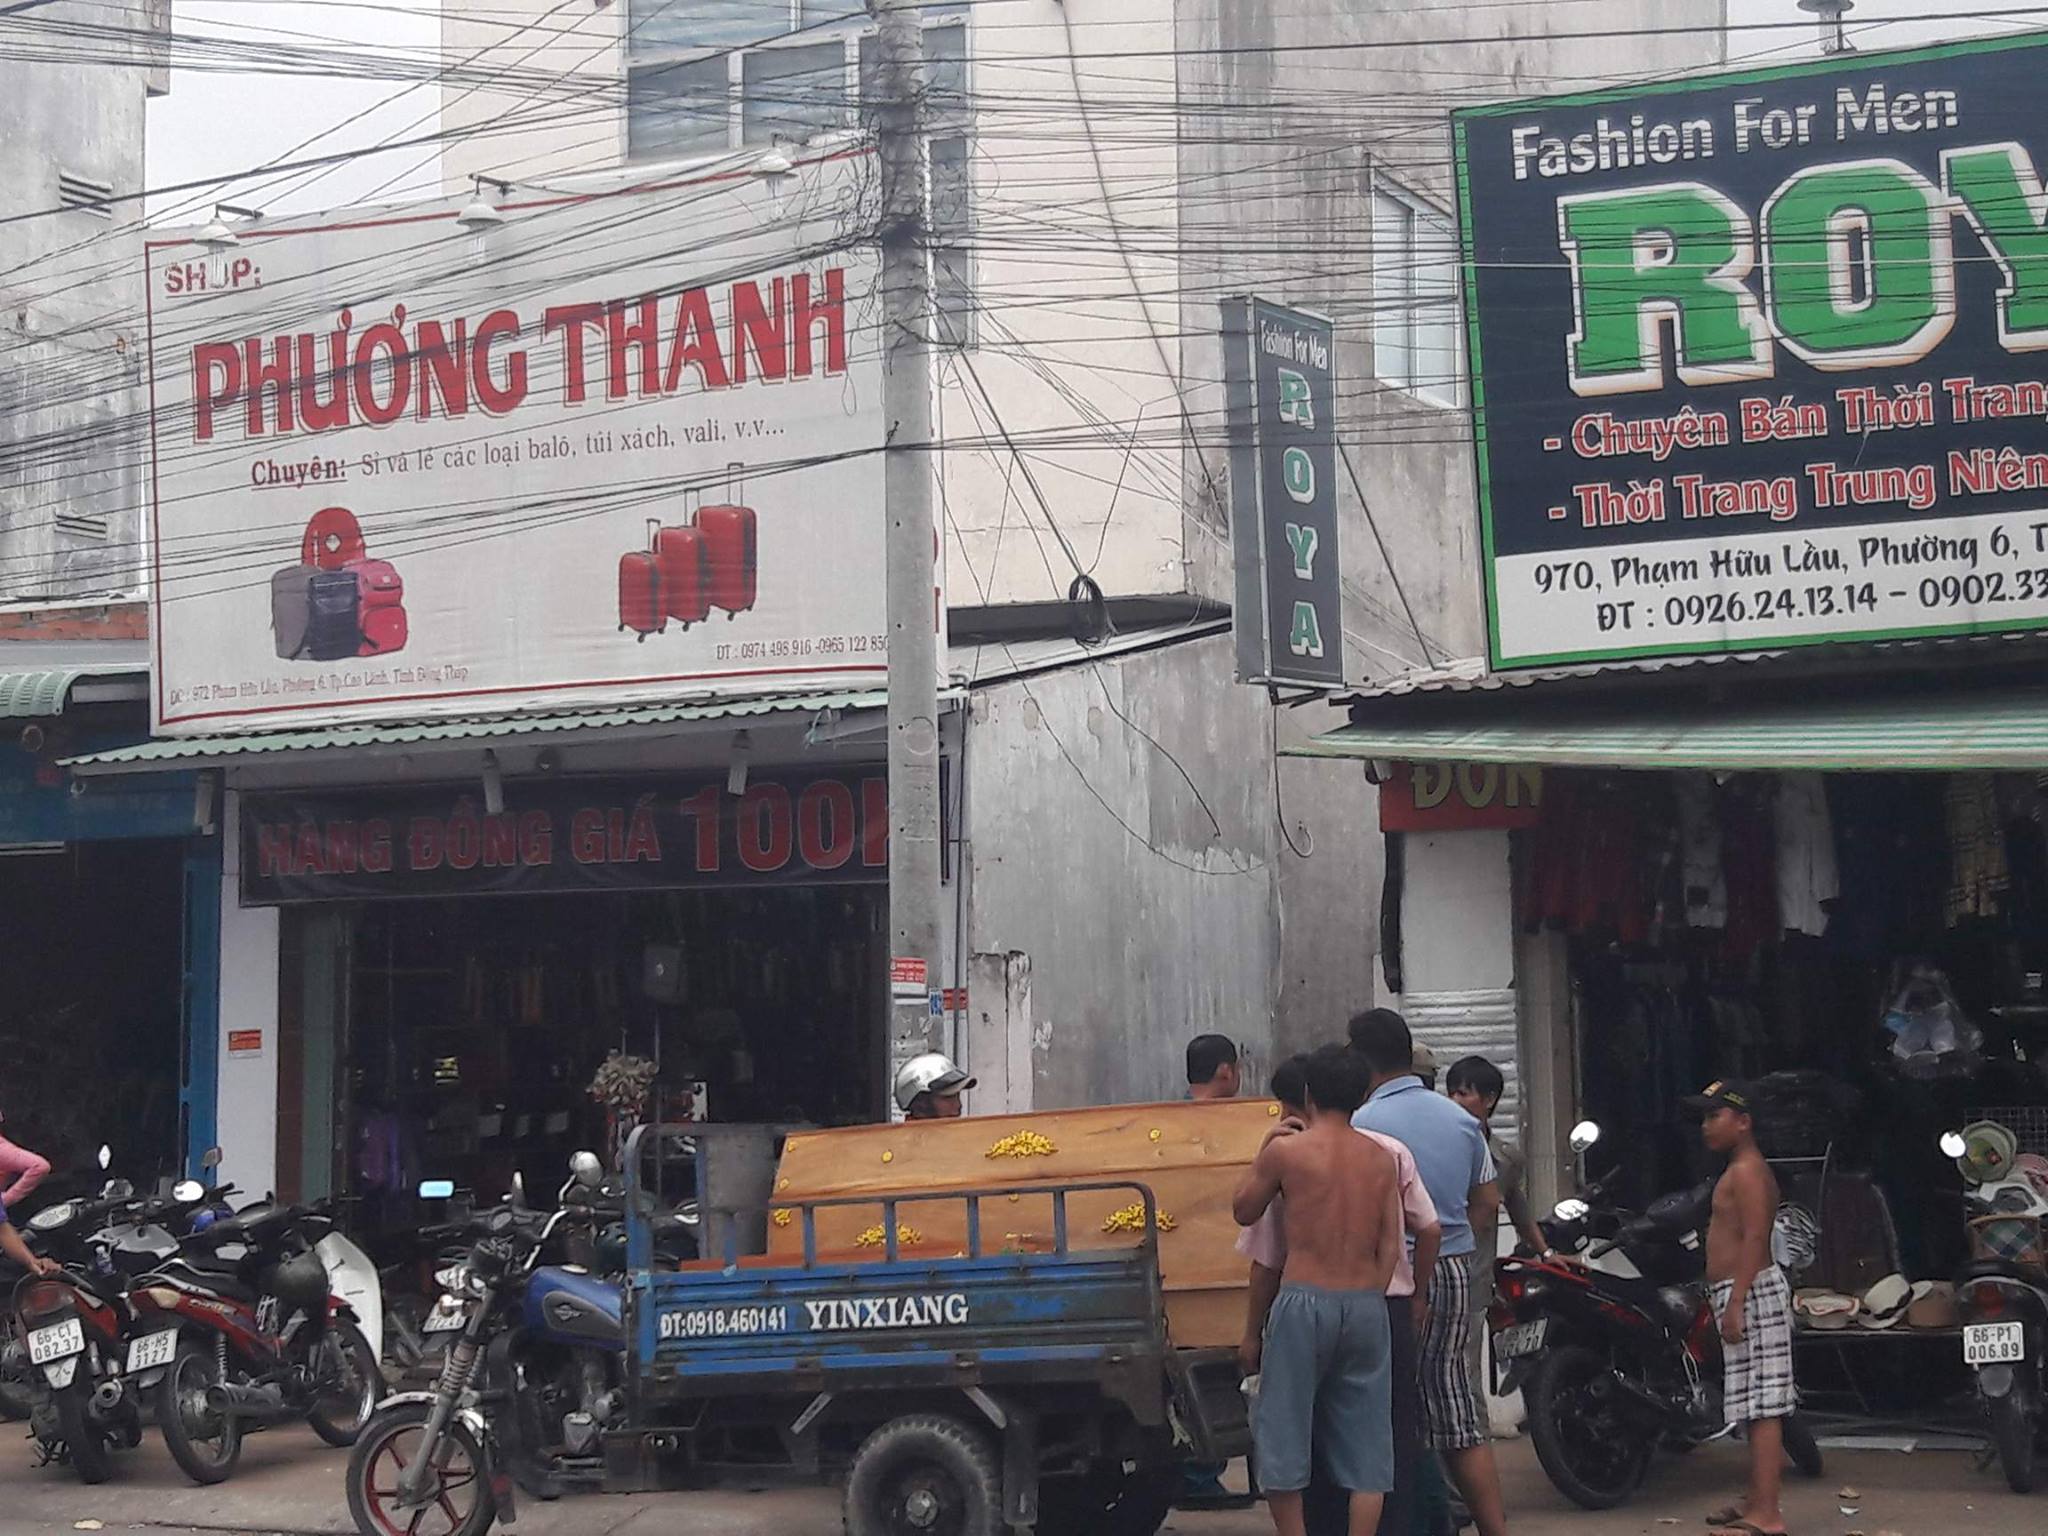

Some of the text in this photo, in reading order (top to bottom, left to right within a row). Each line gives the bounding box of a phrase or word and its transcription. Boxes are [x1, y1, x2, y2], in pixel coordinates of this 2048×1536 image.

[1511, 83, 1959, 180] Fashion For Men
[164, 256, 261, 293] SHP:
[191, 267, 848, 443] PHƯƠNG THANH
[1260, 319, 1293, 360] Fashion
[1294, 331, 1308, 365] For
[251, 455, 347, 489] Chuyên:
[443, 446, 477, 469] các
[484, 441, 520, 468] loại
[528, 434, 577, 460] balô,
[586, 430, 613, 455] túi
[620, 424, 676, 452] xách,
[684, 418, 726, 444] vali,
[1572, 404, 1728, 461] Chuyên
[1740, 395, 1827, 444] Bán
[1836, 382, 1935, 434] Thời
[1573, 476, 1665, 527] Thời
[1674, 474, 1797, 520] Trang
[1806, 460, 1935, 508] Trung
[1534, 561, 1602, 593] 970,
[1611, 555, 1698, 591] Phạm
[1710, 547, 1771, 579] Hữu
[1783, 538, 1850, 576] Lầu,
[1858, 532, 1979, 573] Phường
[1990, 525, 2019, 561] 6,
[1597, 600, 1634, 633] ĐT
[1664, 581, 1878, 628] 0926.24.13.14
[571, 792, 663, 865] GIÁ
[805, 1293, 969, 1331] YINXIANG
[1974, 1326, 2011, 1343] 66-P1
[1968, 1342, 2019, 1360] 006.89
